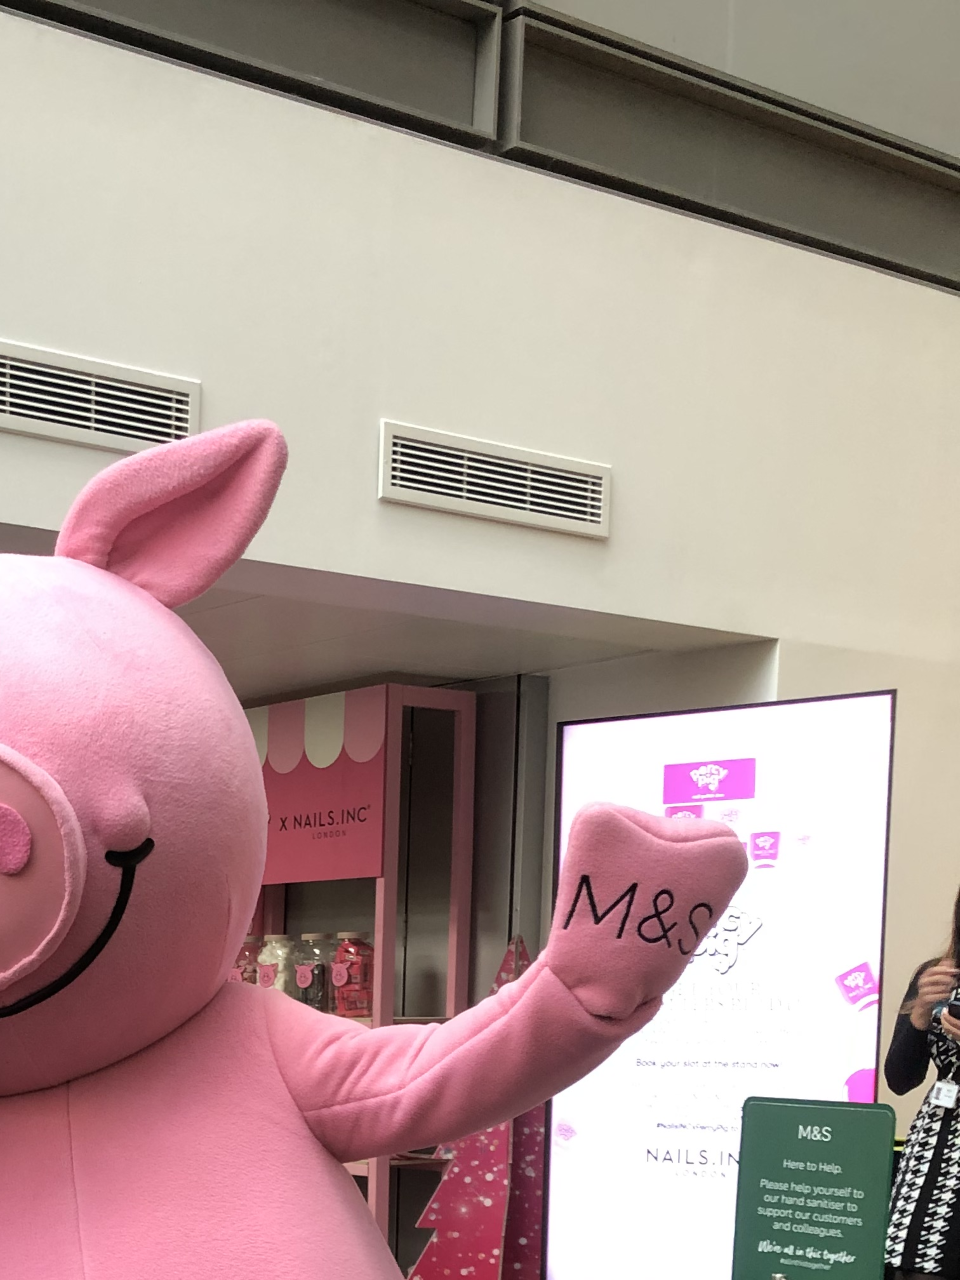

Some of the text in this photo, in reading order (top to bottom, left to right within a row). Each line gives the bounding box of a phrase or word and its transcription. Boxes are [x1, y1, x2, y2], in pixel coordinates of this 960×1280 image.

[279, 816, 288, 832] X
[312, 830, 347, 840] LONDON
[562, 874, 714, 956] M&S
[636, 1058, 657, 1067] Book
[660, 1060, 680, 1069] your
[683, 1060, 699, 1068] slot
[702, 1060, 711, 1068] at
[714, 1060, 729, 1068] the
[732, 1060, 758, 1069] stand
[797, 1124, 832, 1142] M&S
[646, 1148, 740, 1166] NAILS.IN
[783, 1158, 805, 1170] Here
[806, 1161, 817, 1171] to
[760, 1178, 865, 1199] Please help yourself to
[763, 1194, 858, 1212] our hand sanitiser to
[757, 1206, 863, 1226] support our customers
[772, 1221, 791, 1231] and
[783, 1245, 794, 1255] all
[795, 1246, 804, 1256] in
[805, 1246, 821, 1258] this
[823, 1249, 856, 1264] together
